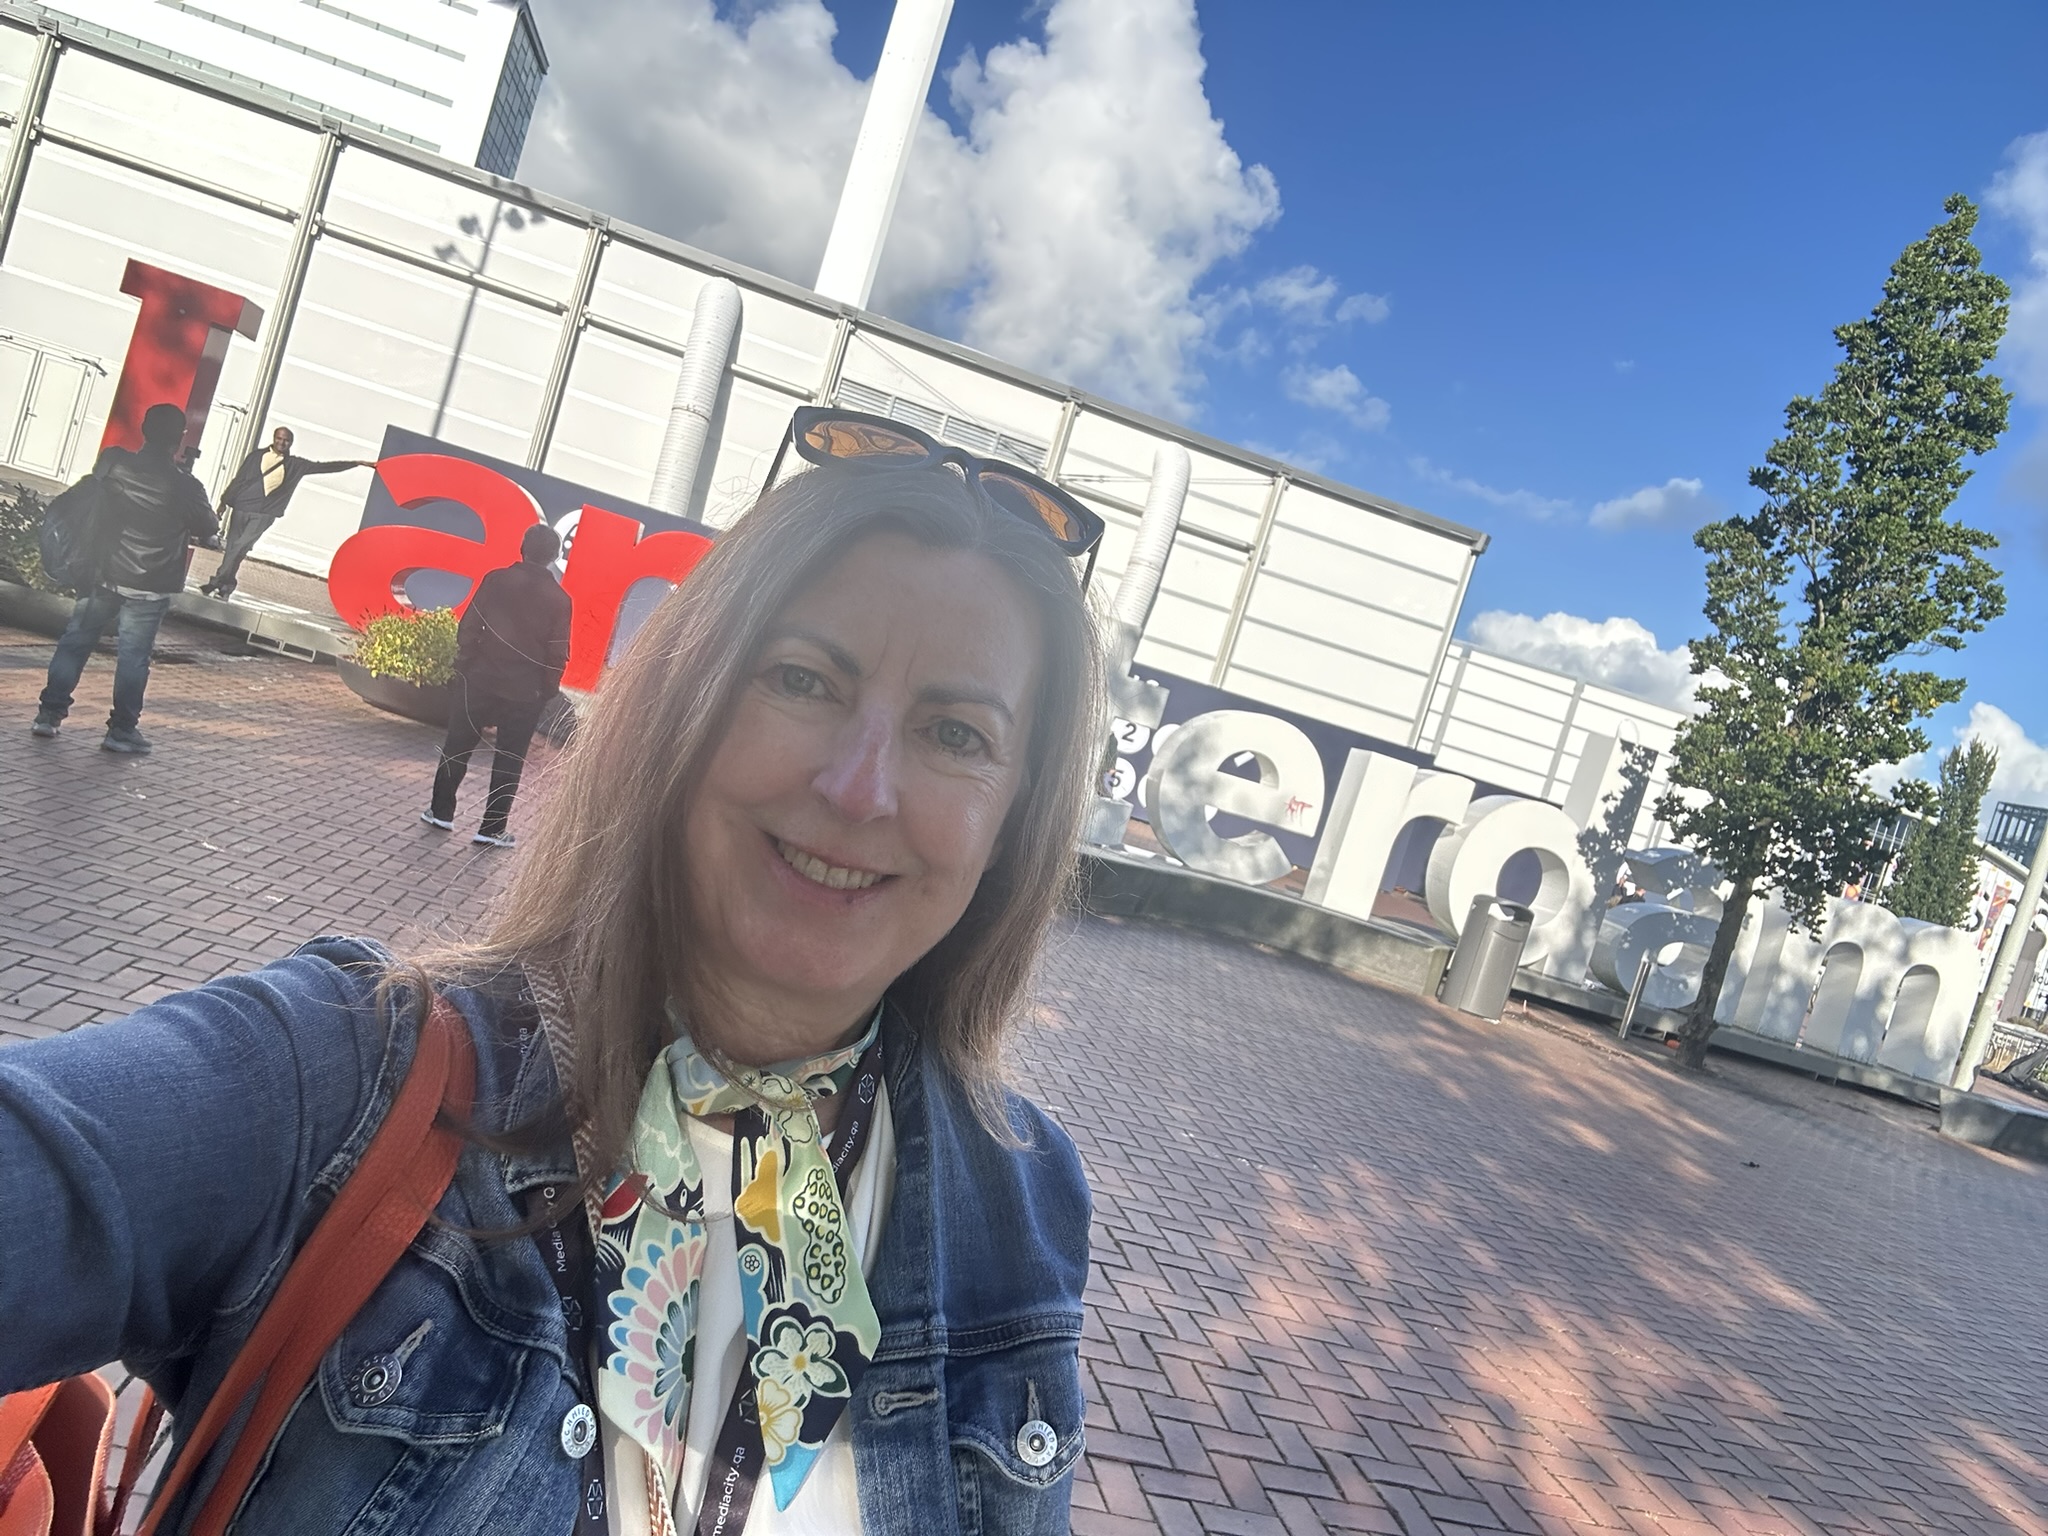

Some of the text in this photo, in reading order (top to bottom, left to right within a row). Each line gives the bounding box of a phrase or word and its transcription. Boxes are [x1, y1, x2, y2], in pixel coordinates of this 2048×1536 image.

[1121, 722, 1137, 743] 2
[832, 1120, 859, 1174] diacity.qa
[553, 1230, 567, 1272] Media
[712, 1446, 745, 1536] mediacity.qa
